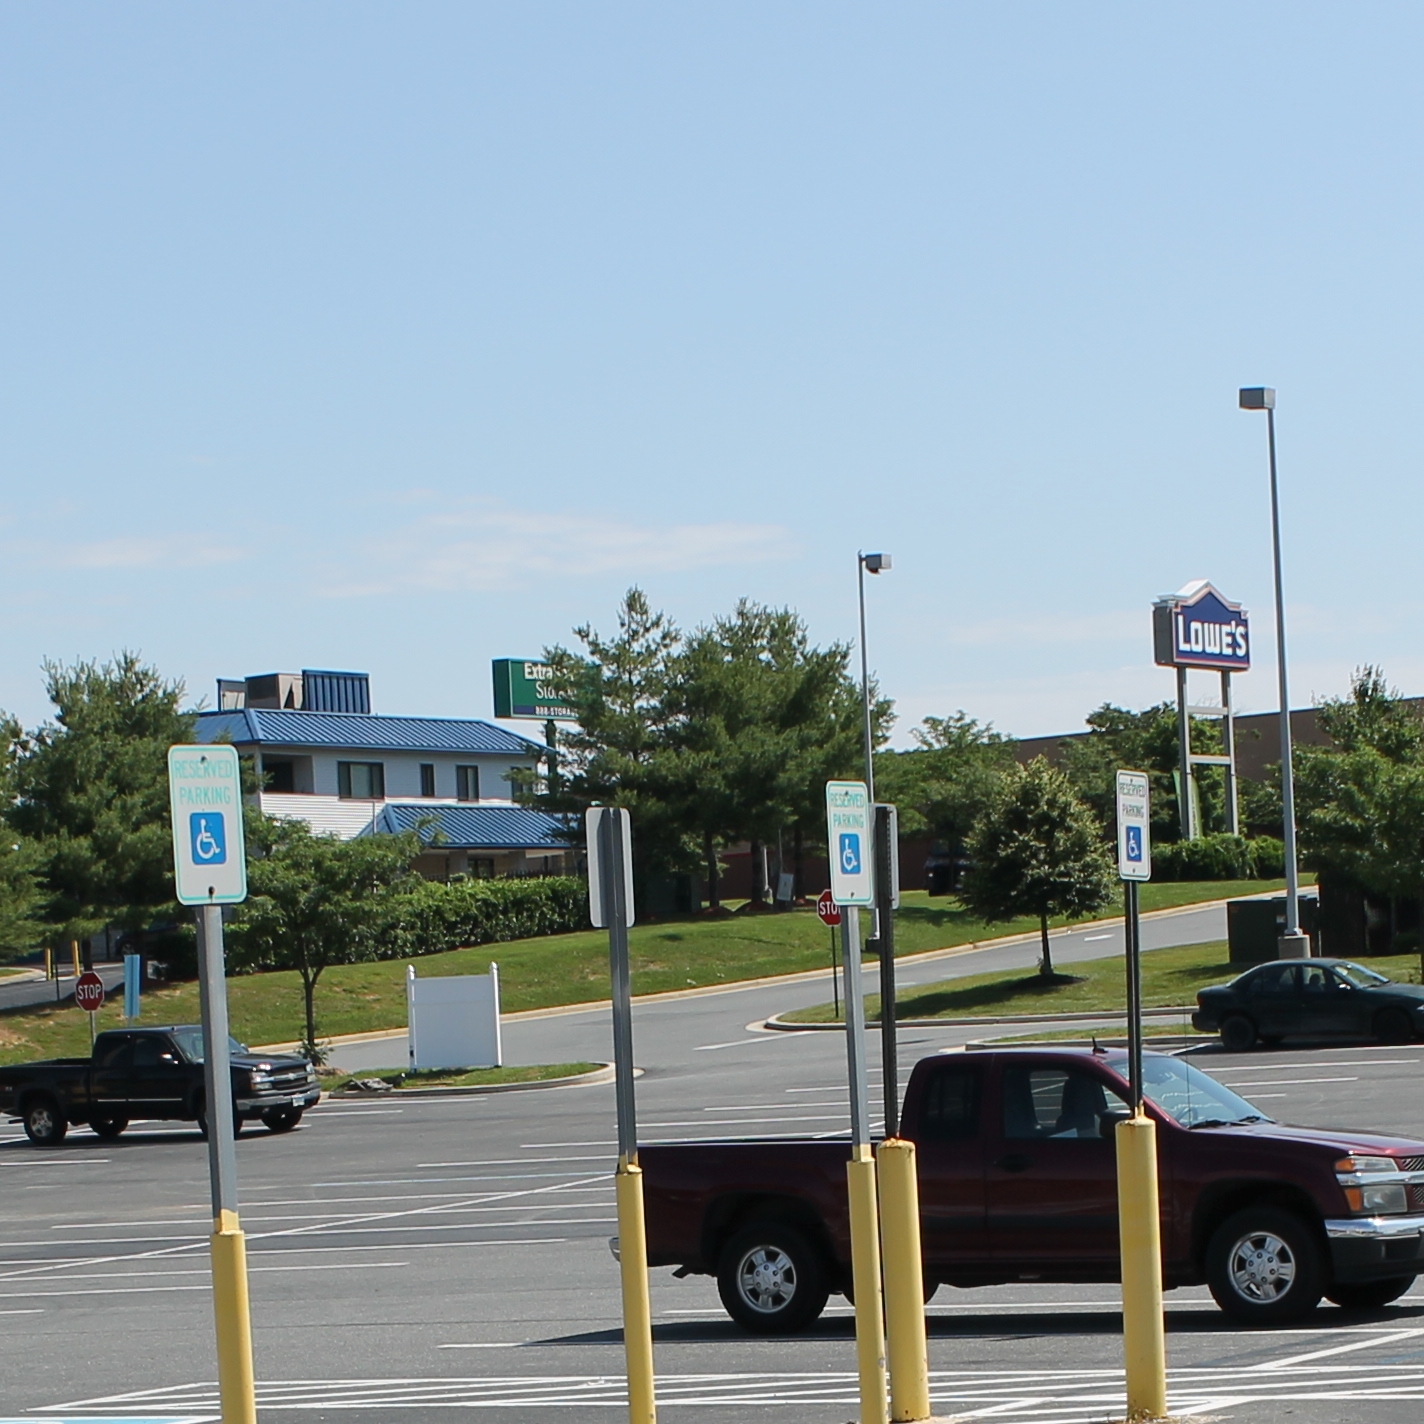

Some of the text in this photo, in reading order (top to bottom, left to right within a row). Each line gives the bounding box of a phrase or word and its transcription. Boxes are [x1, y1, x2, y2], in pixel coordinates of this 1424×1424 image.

[1177, 614, 1247, 657] LOWE'S
[524, 662, 553, 680] Extra
[173, 760, 233, 779] RESERVED
[179, 786, 231, 805] PARKING
[1119, 782, 1146, 798] RESERVED
[829, 792, 864, 808] RESERVED
[1121, 803, 1144, 819] PARKING
[832, 813, 865, 829] PARKING
[78, 984, 102, 1000] STOP
